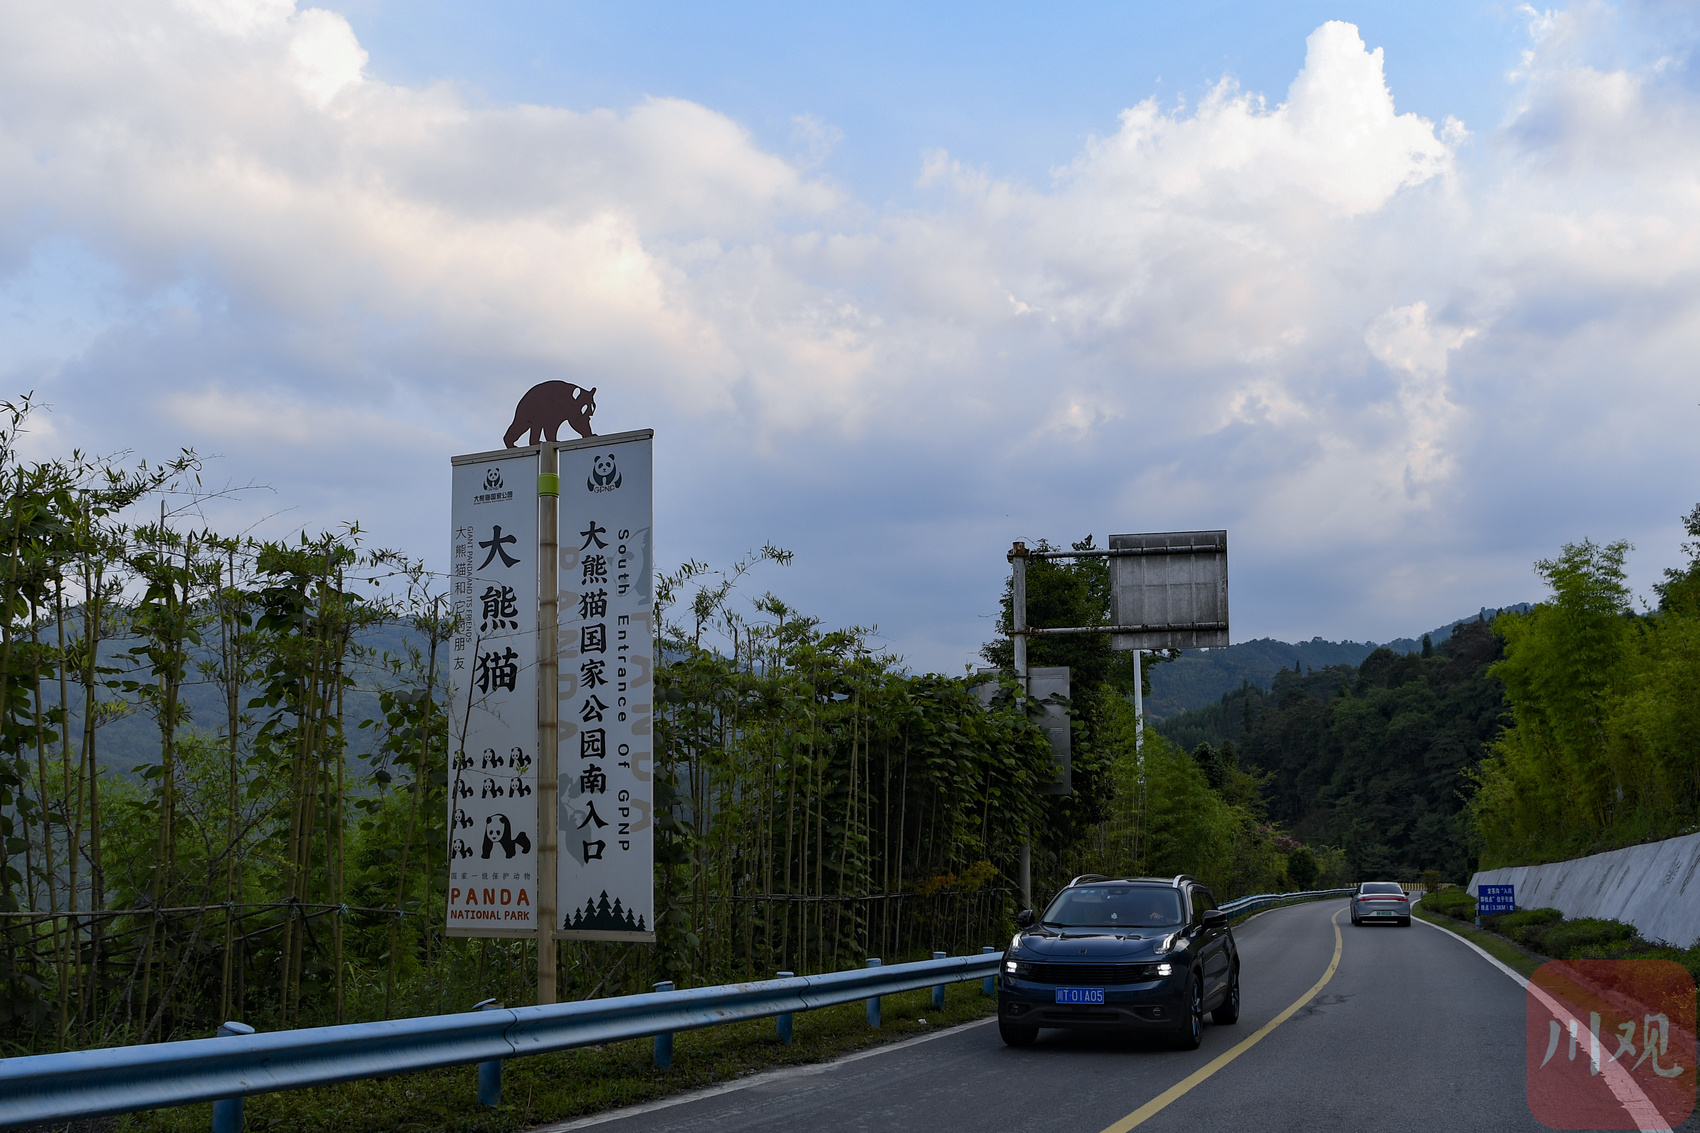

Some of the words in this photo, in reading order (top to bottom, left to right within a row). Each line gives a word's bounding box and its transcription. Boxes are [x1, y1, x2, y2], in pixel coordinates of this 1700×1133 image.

[618, 529, 630, 595] South
[465, 609, 473, 643] FRIENDS
[475, 525, 520, 694] 大熊猫
[577, 520, 609, 864] 大熊猫国家公园南入口
[618, 615, 630, 723] Entrance
[618, 743, 630, 769] Of
[618, 789, 630, 851] GPNP
[451, 872, 531, 881] 国家一级保护动物
[451, 888, 530, 906] PANDA
[450, 909, 501, 920] NATIONAL
[504, 910, 530, 921] PARK
